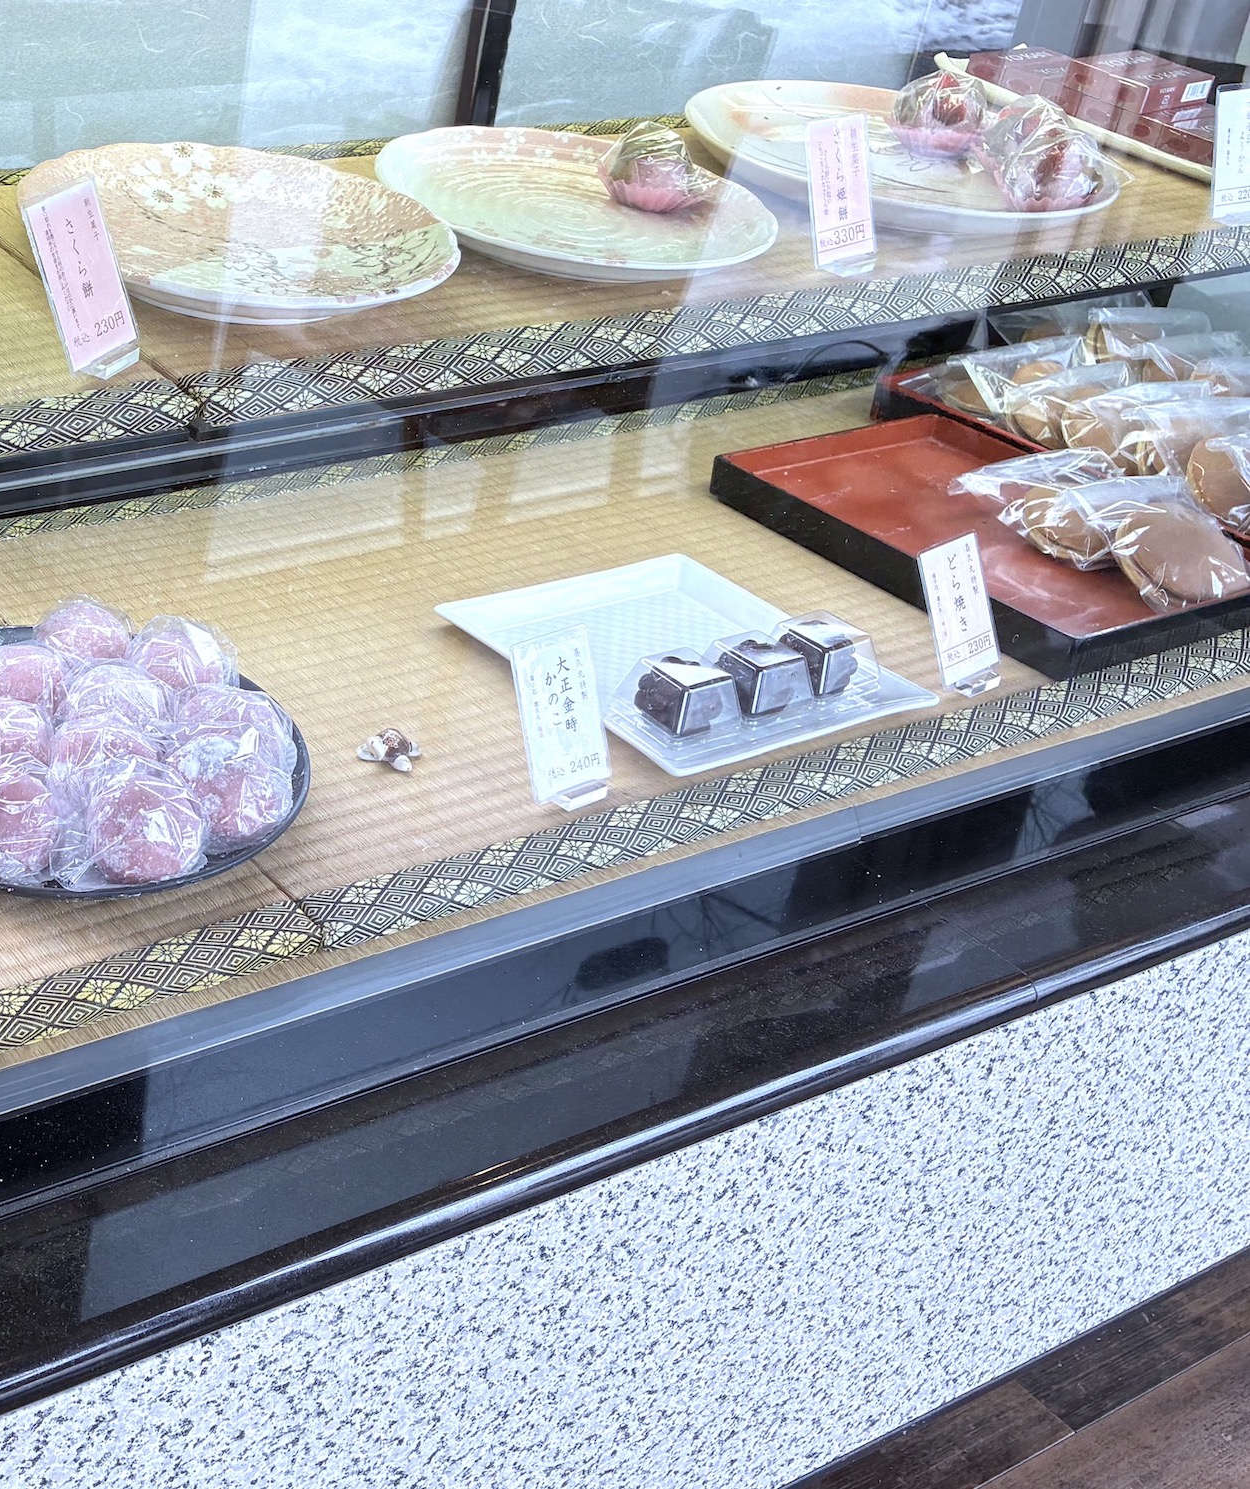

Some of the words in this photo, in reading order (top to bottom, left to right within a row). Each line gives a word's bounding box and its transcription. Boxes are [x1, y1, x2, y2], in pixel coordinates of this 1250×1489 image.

[833, 223, 866, 246] 330円
[64, 218, 94, 299] さくら餅
[73, 332, 91, 349] 税込
[94, 310, 126, 338] 230円
[947, 553, 968, 632] どら焼き
[967, 634, 991, 654] 230円
[545, 671, 563, 726] かのこ
[556, 656, 579, 733] 大正金時
[569, 752, 601, 774] 240円
